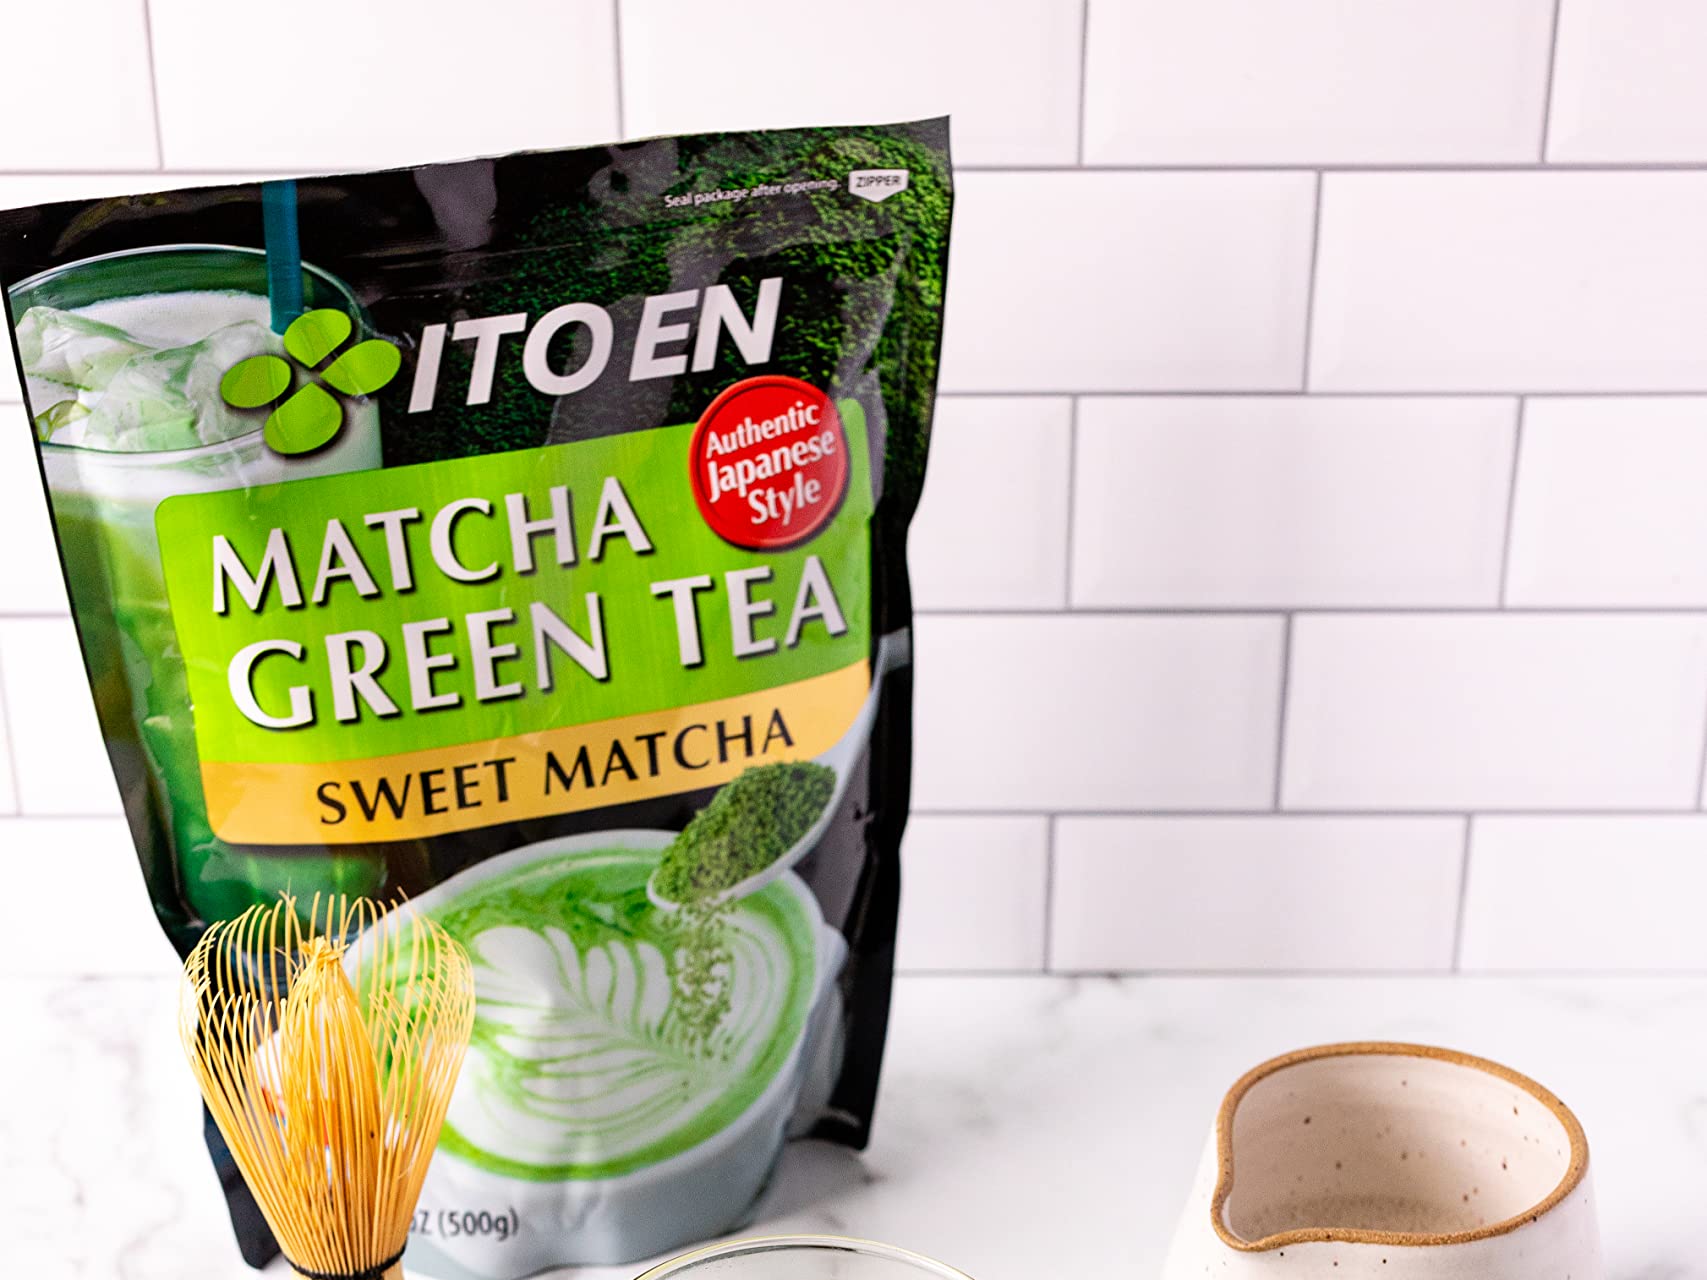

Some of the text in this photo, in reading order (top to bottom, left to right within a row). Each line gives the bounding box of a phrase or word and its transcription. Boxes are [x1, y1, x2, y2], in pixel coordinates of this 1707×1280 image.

[663, 193, 693, 208] Seal
[694, 187, 750, 207] package
[751, 183, 782, 198] after
[854, 174, 902, 189] ZIPPER
[408, 277, 783, 414] ITO EN
[706, 401, 820, 460] Authentic
[707, 430, 836, 504] Japanese
[748, 471, 822, 526] Style
[211, 476, 653, 615] MATCHA
[227, 555, 849, 731] GREEN TEA
[316, 708, 796, 825] SWEET MATCHA
[438, 1205, 520, 1241] (500g)
